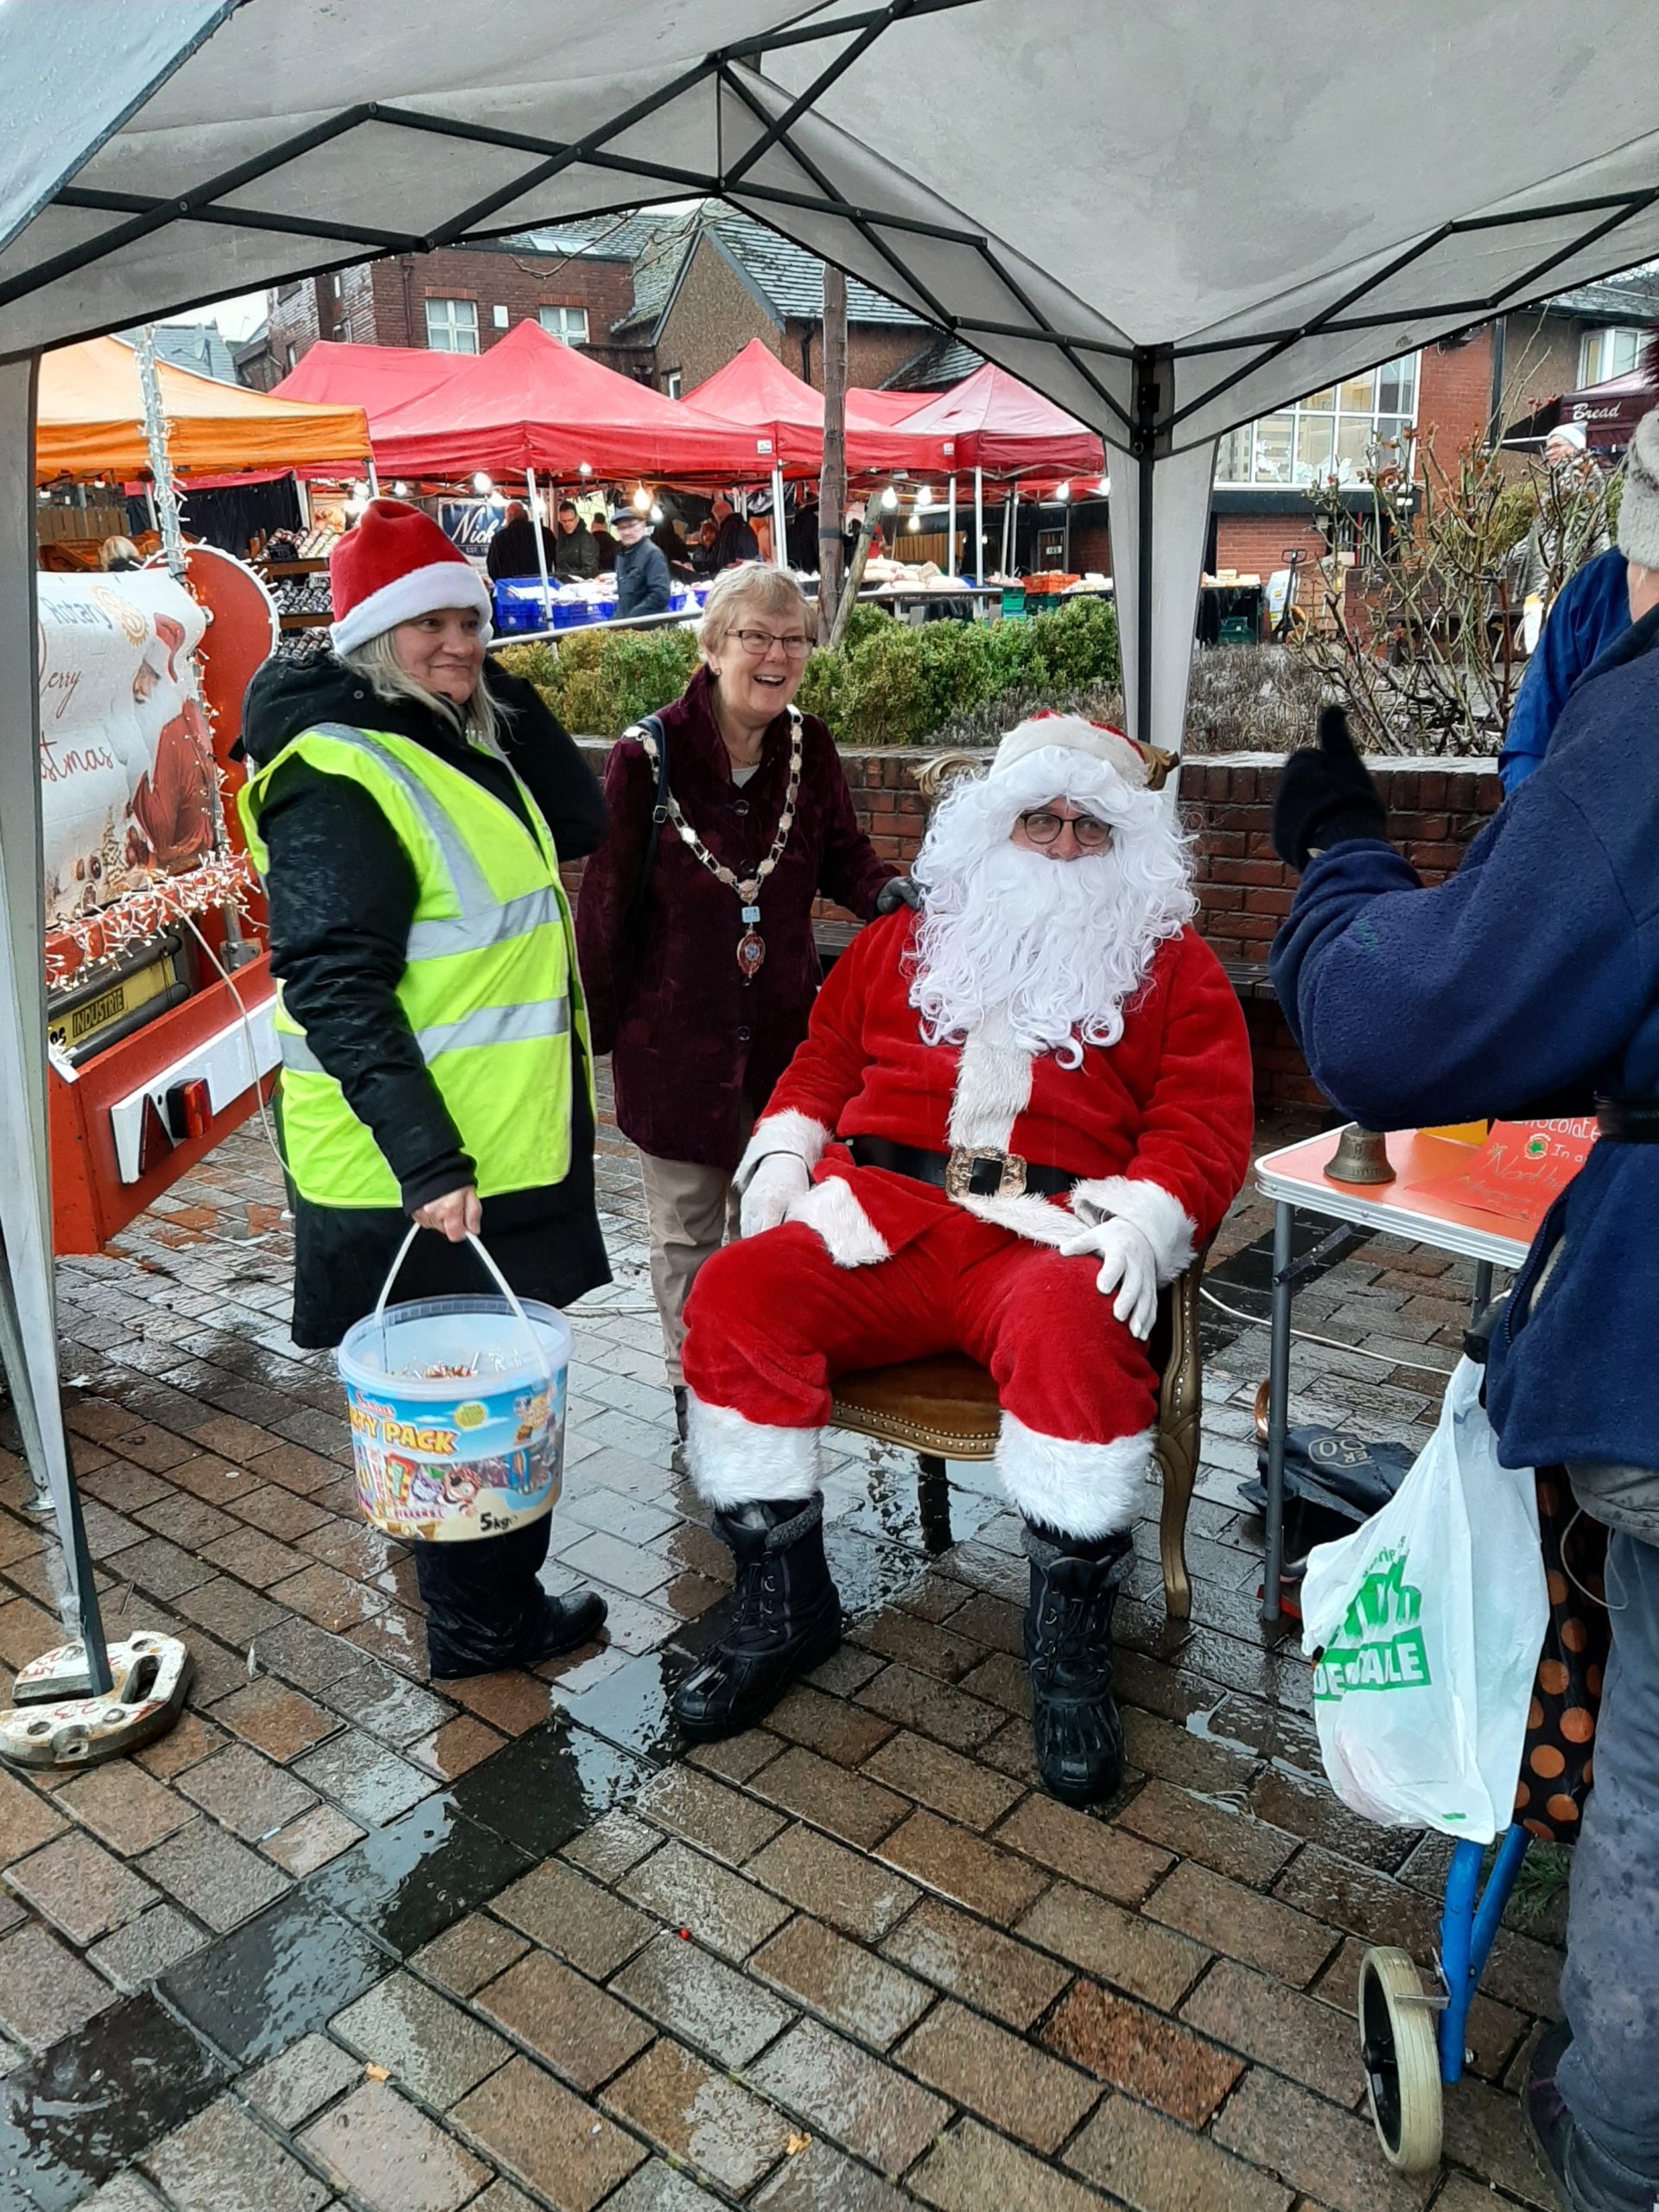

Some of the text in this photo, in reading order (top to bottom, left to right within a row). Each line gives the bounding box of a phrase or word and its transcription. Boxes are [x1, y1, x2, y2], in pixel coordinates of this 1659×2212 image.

[1573, 402, 1622, 421] Bread
[40, 596, 113, 629] Rotary
[73, 988, 123, 1037] INDUSTRIE
[385, 1421, 456, 1455] PACK
